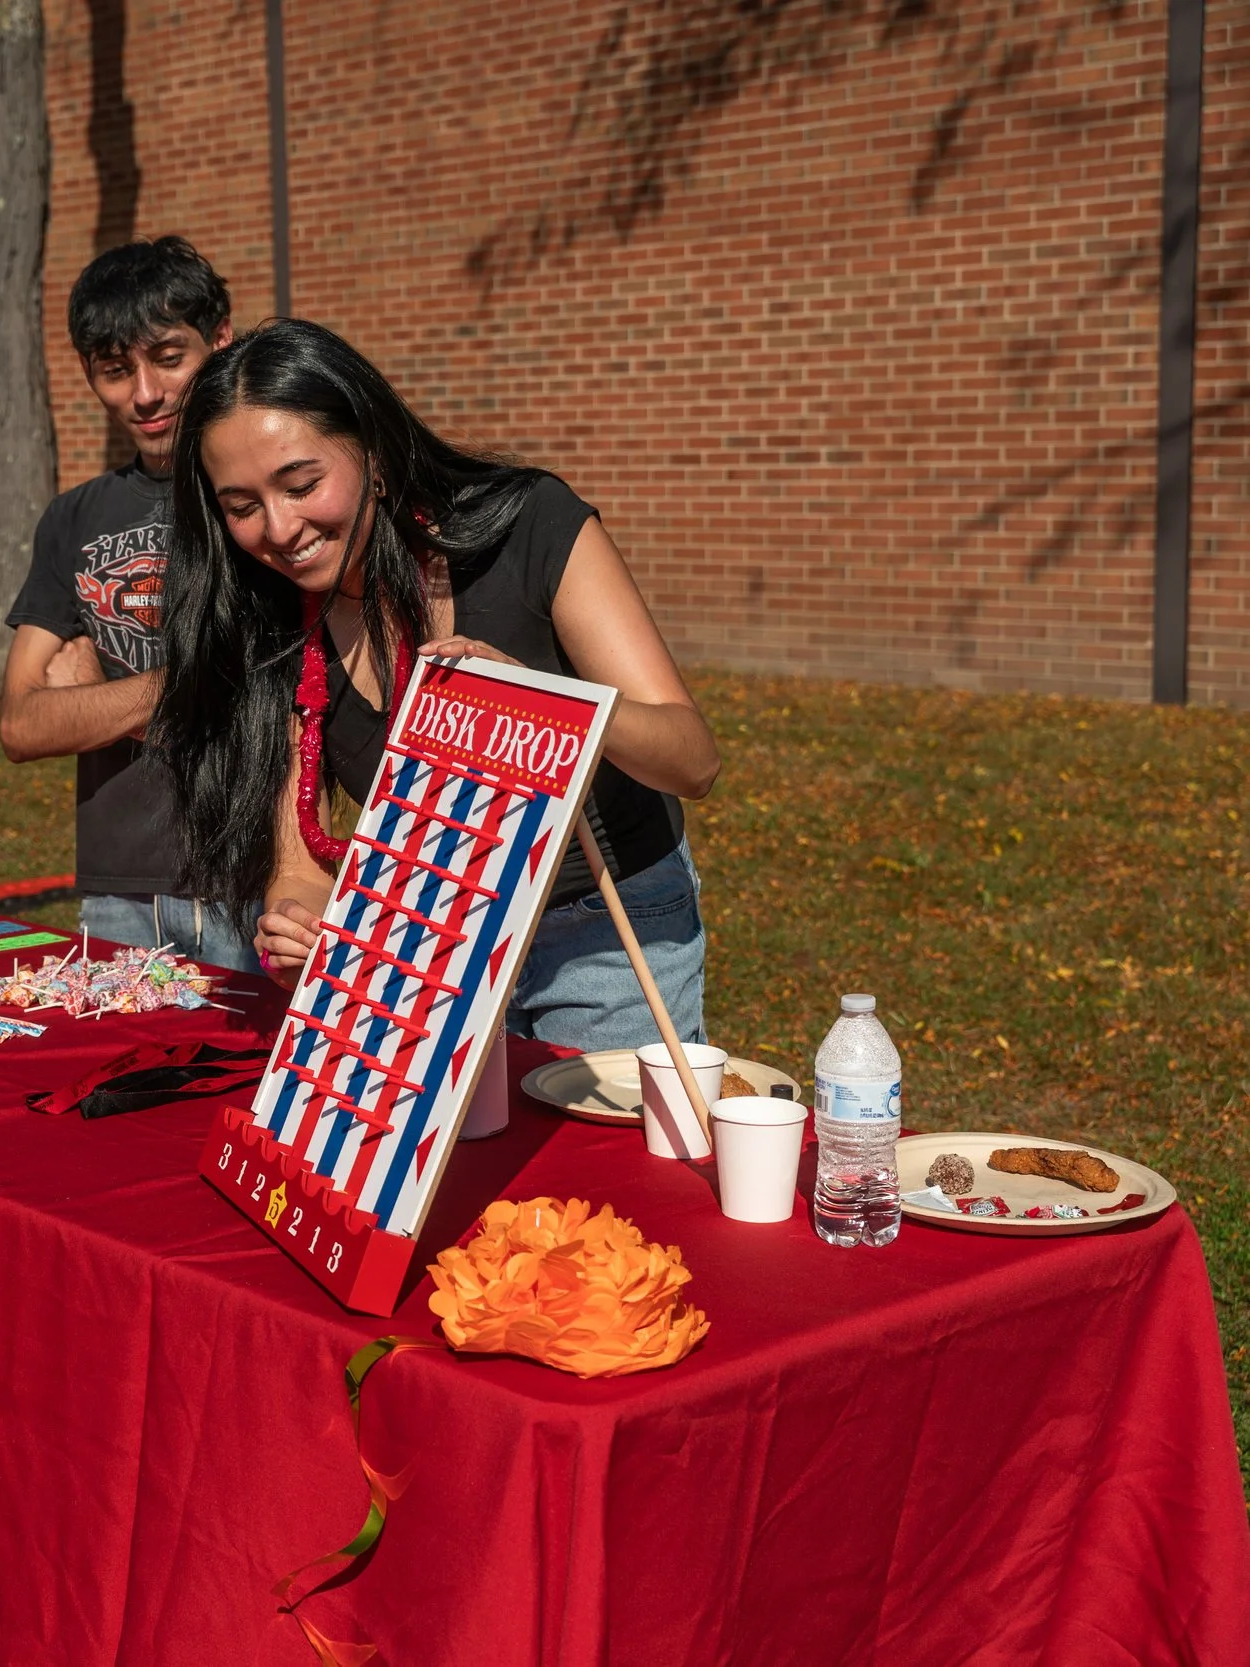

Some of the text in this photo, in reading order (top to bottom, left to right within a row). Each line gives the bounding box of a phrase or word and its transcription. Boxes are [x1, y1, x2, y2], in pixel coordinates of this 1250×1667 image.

[408, 692, 580, 779] DISK DROP
[218, 1143, 343, 1273] 3 1 2 5 2 1 3
